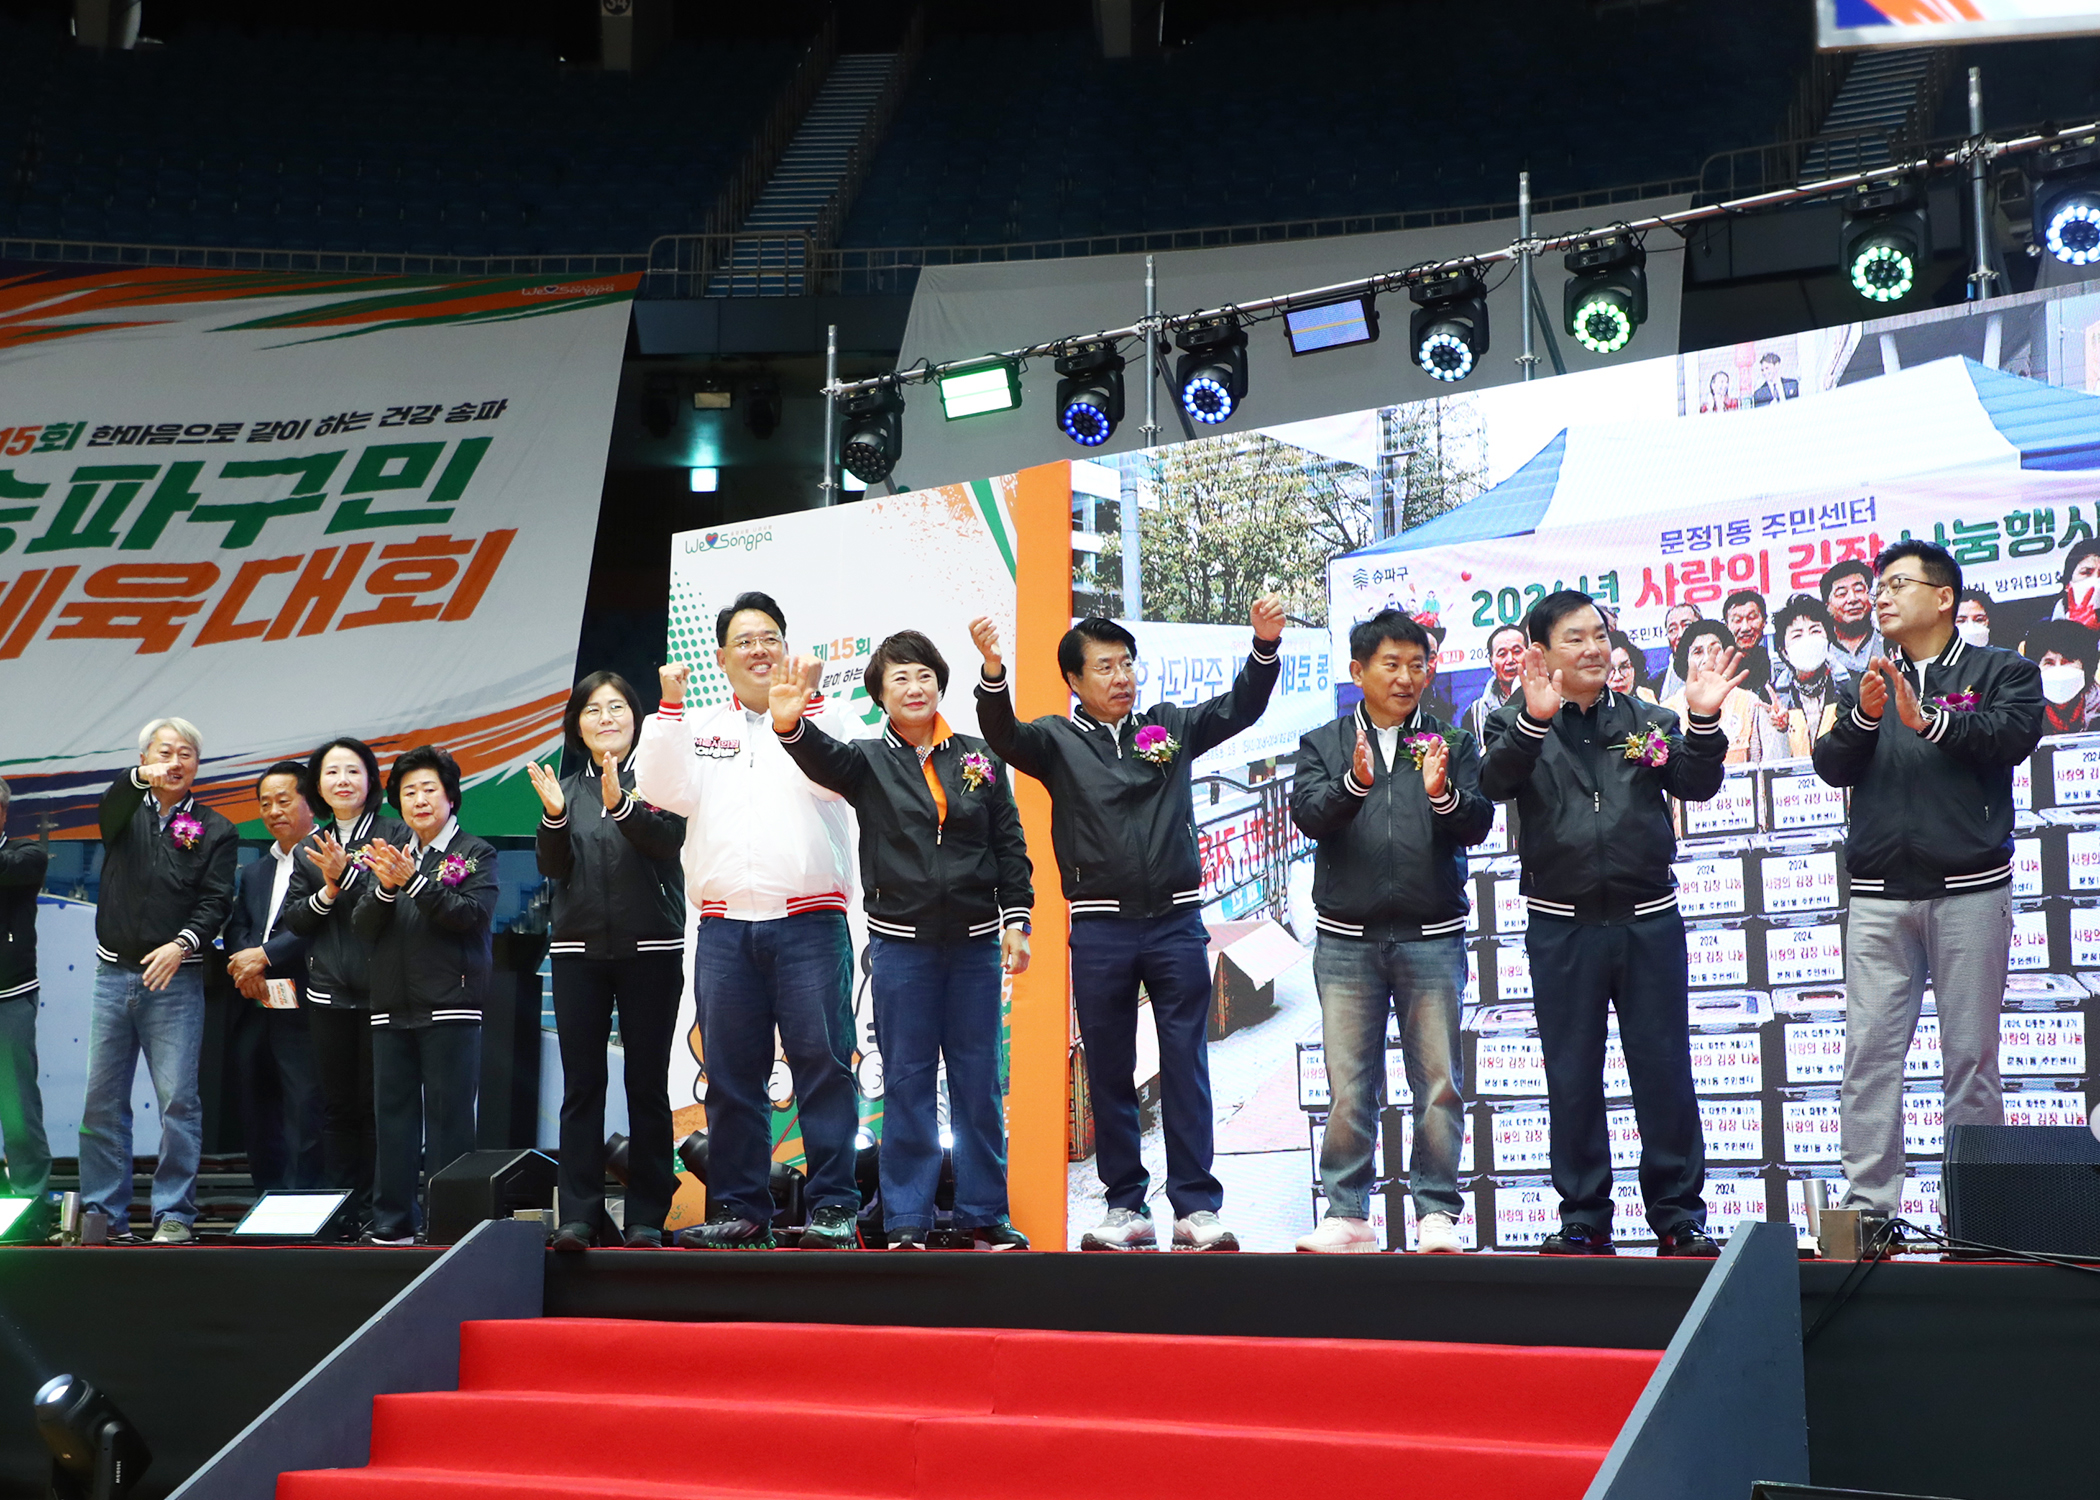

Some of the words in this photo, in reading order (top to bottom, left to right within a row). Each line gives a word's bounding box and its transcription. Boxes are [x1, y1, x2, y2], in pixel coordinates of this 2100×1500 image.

[87, 421, 244, 448] 한마음으로
[246, 418, 310, 444] 같이
[314, 409, 374, 440] 하는
[379, 402, 444, 429] 건강
[444, 399, 510, 425] 송파
[1660, 518, 1752, 555] 문정1동
[1761, 496, 1877, 539] 주민센터
[1372, 566, 1409, 585] 송파구
[1471, 570, 1620, 628] 202년
[1634, 549, 1770, 608] 사랑의
[813, 636, 871, 662] 제15회
[843, 667, 864, 683] 하는
